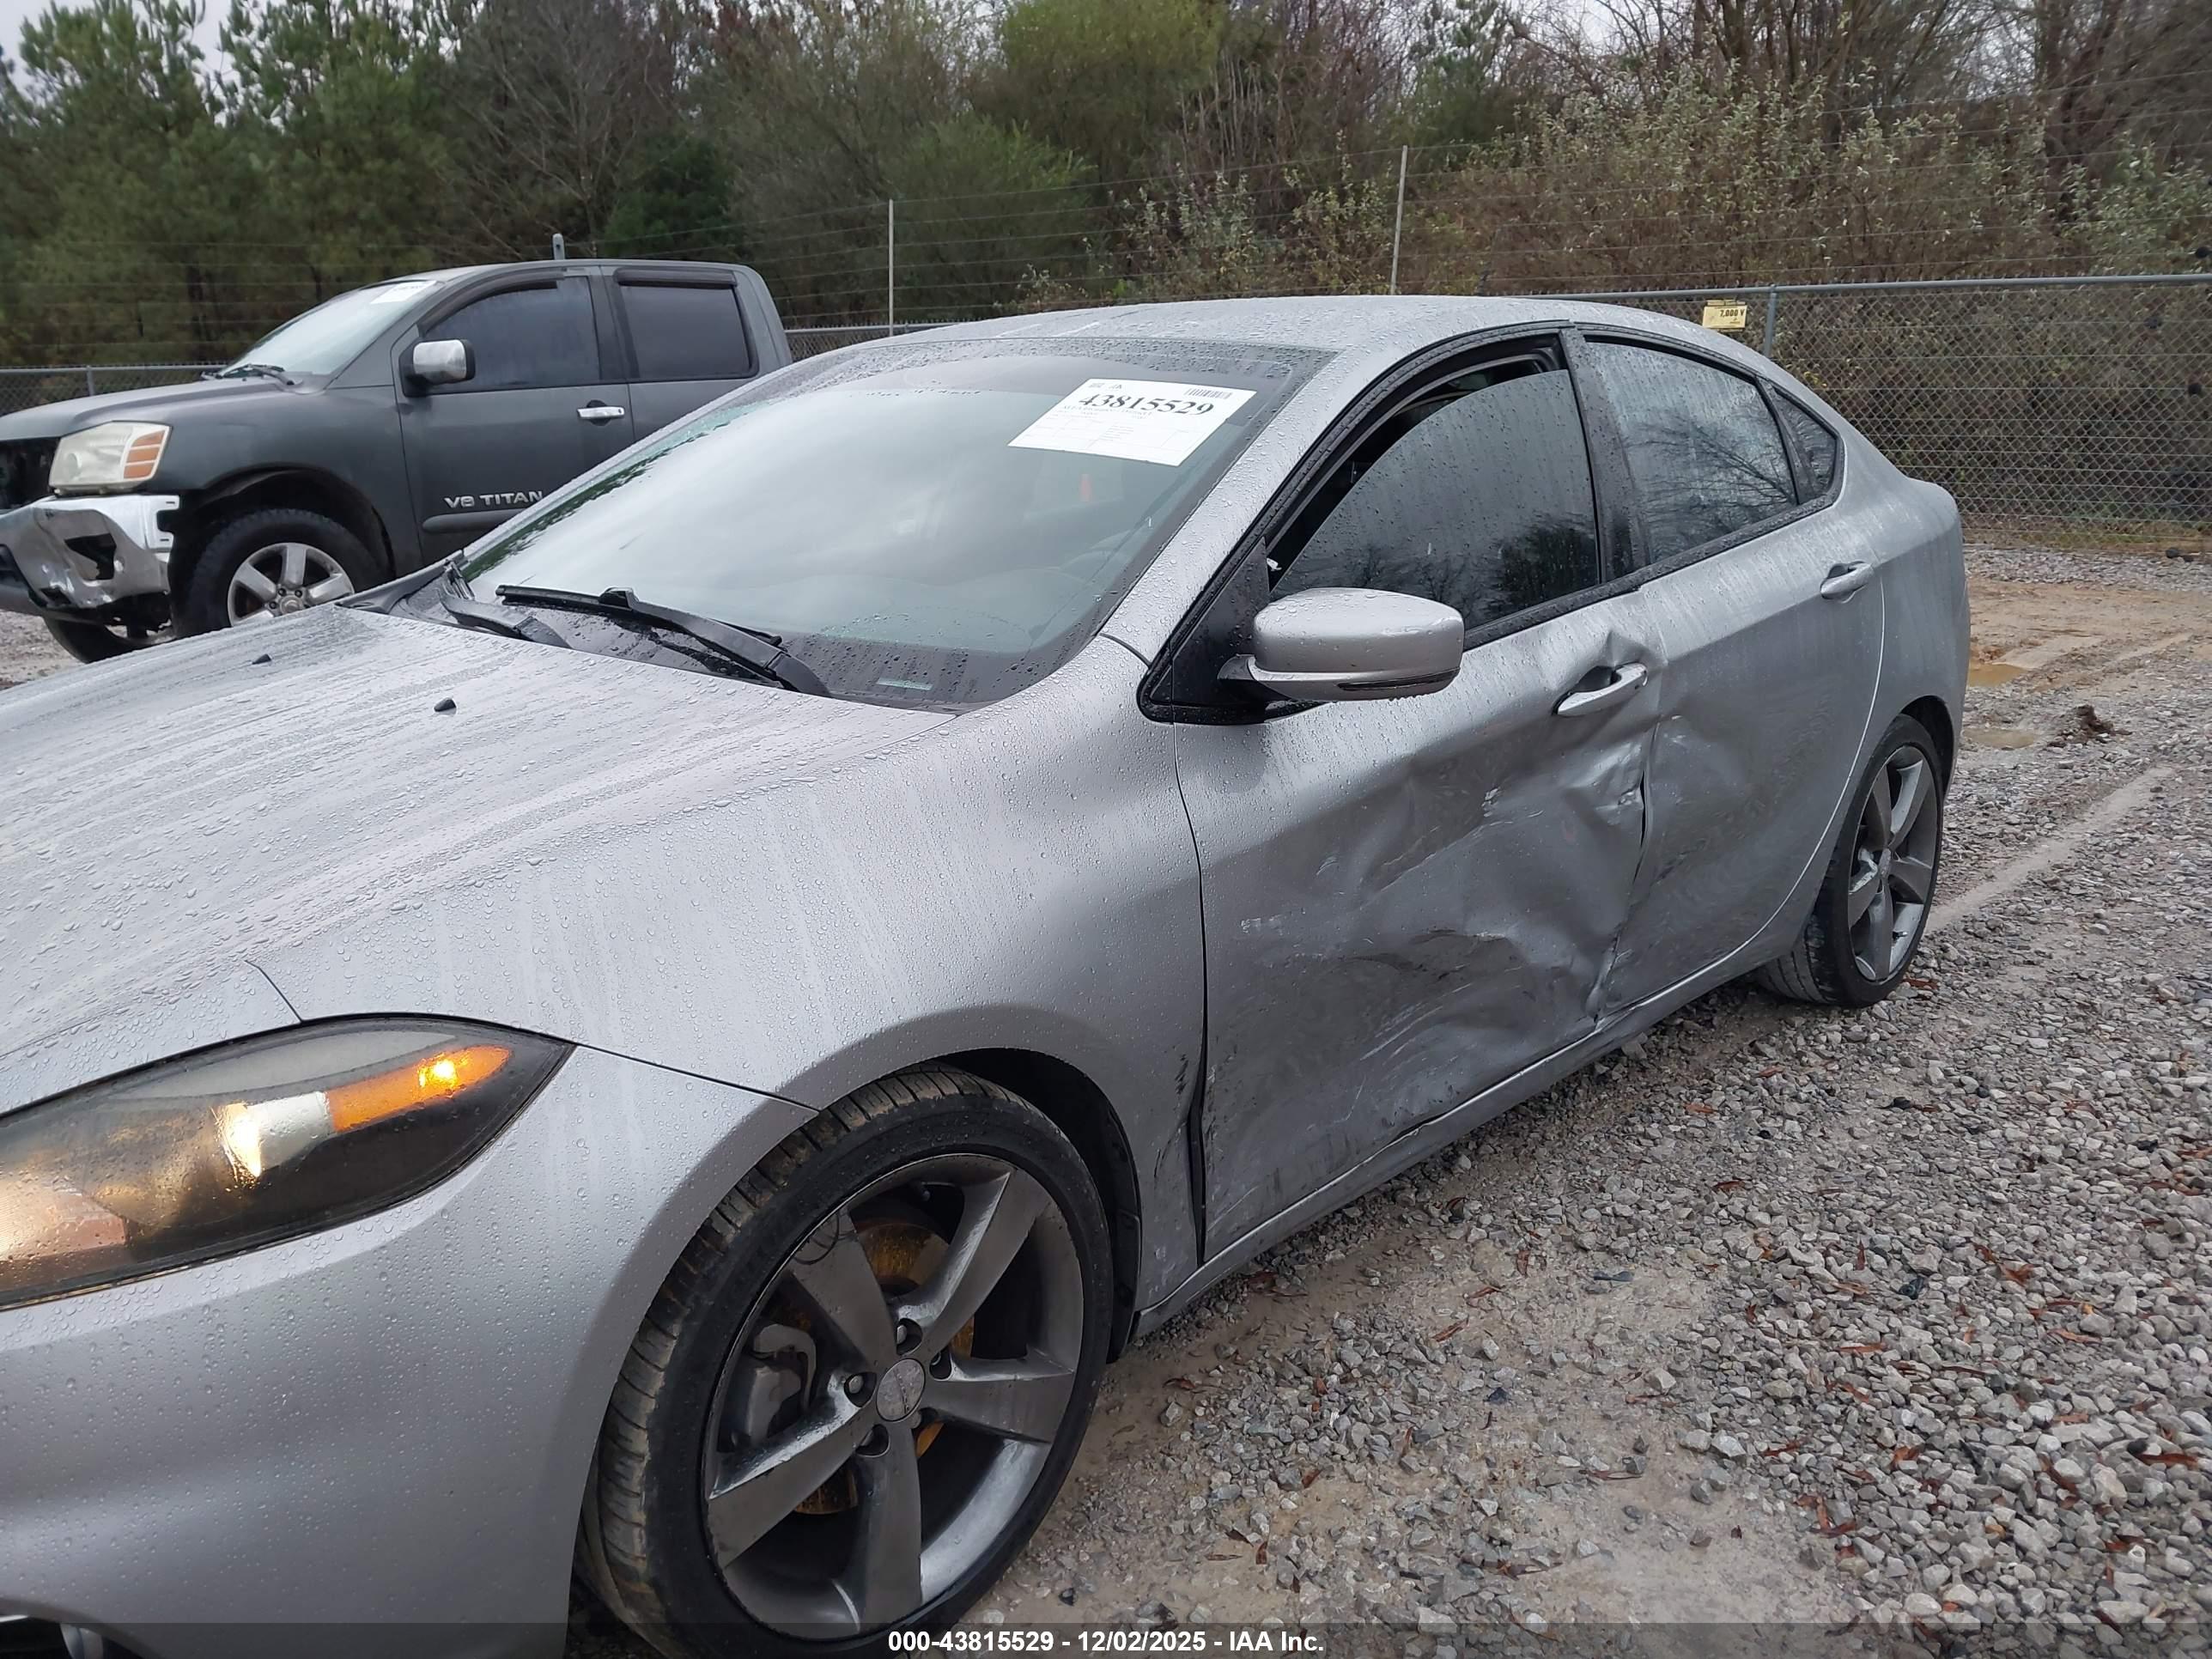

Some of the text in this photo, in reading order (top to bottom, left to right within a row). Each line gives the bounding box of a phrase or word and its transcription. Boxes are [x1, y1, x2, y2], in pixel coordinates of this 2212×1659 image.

[1078, 393, 1215, 416] 43815529
[444, 490, 543, 508] V8 TITAN
